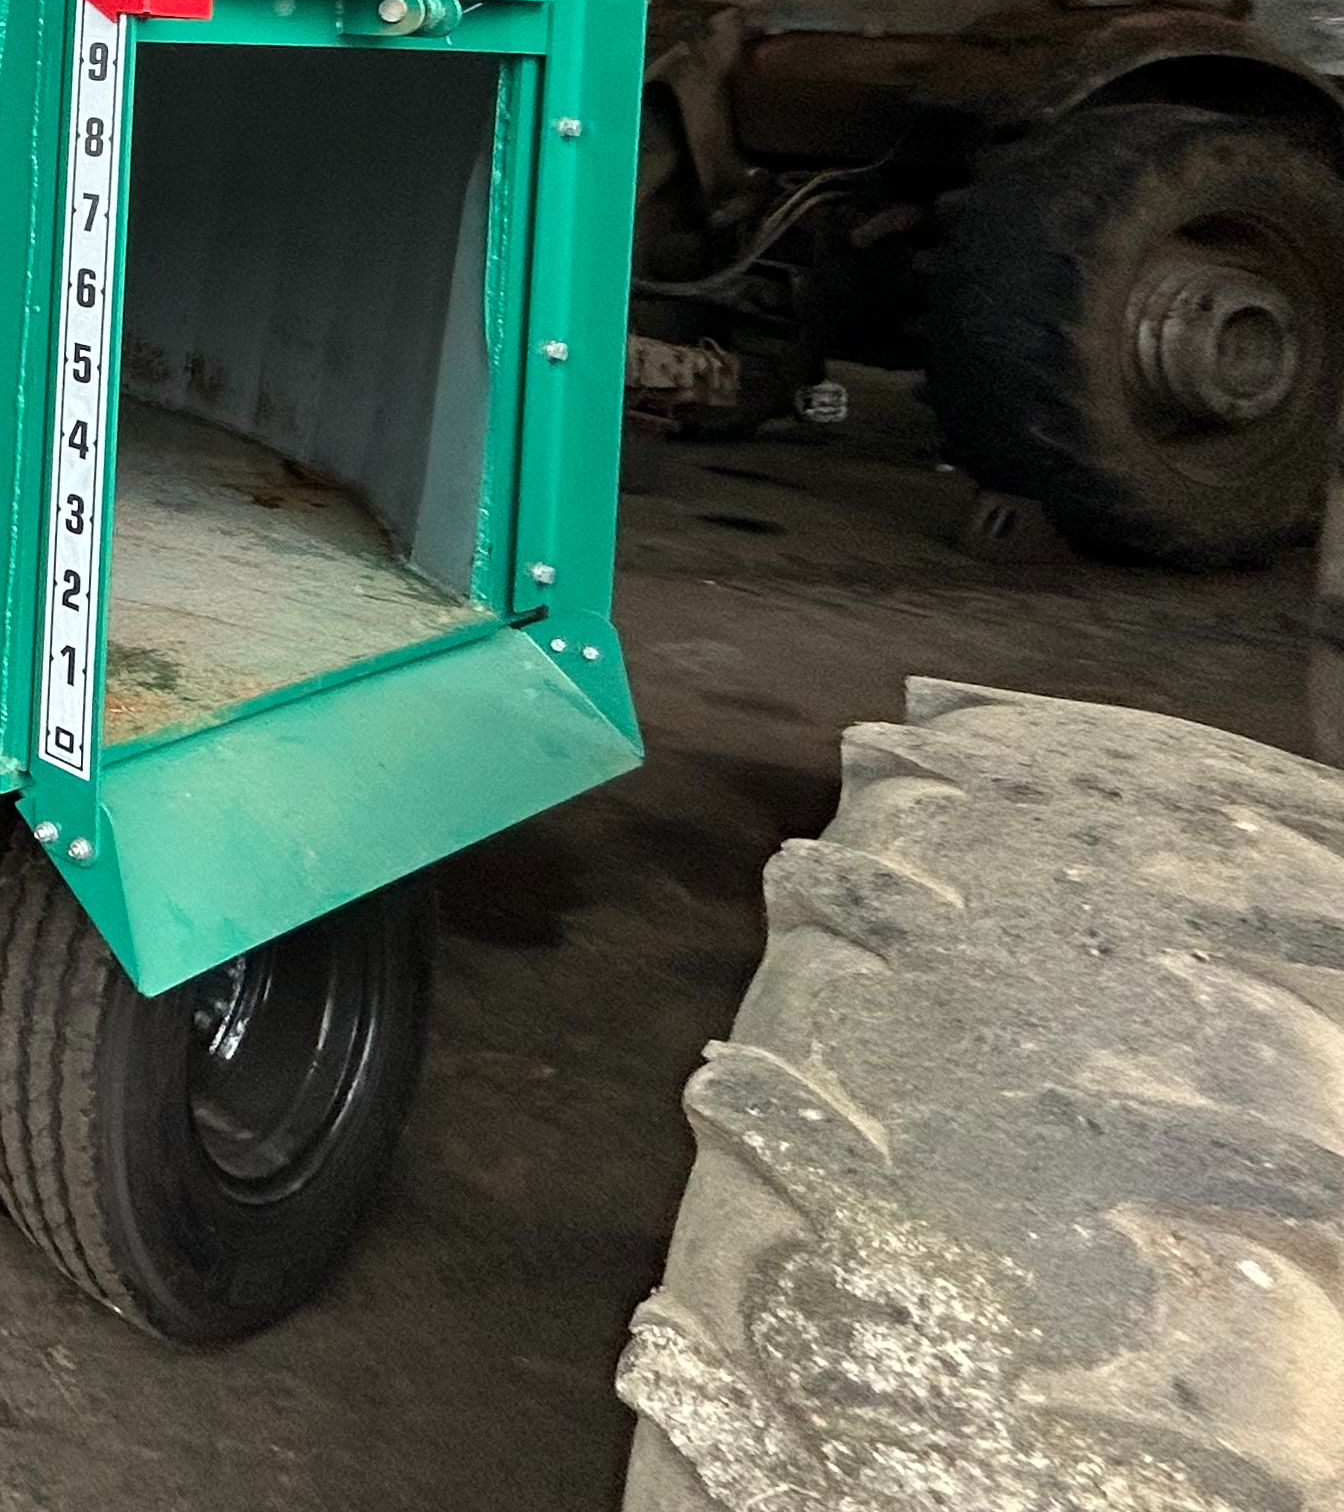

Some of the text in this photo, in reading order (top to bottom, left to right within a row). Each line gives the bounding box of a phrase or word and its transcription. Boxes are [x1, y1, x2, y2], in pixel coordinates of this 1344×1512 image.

[88, 42, 109, 82] 9
[84, 117, 104, 157] 8
[82, 192, 100, 233] 7
[76, 268, 96, 308] 6
[73, 342, 92, 384] 5
[68, 420, 89, 460] 4
[65, 494, 85, 536] 3
[62, 569, 80, 612] 2
[60, 645, 75, 687] 1
